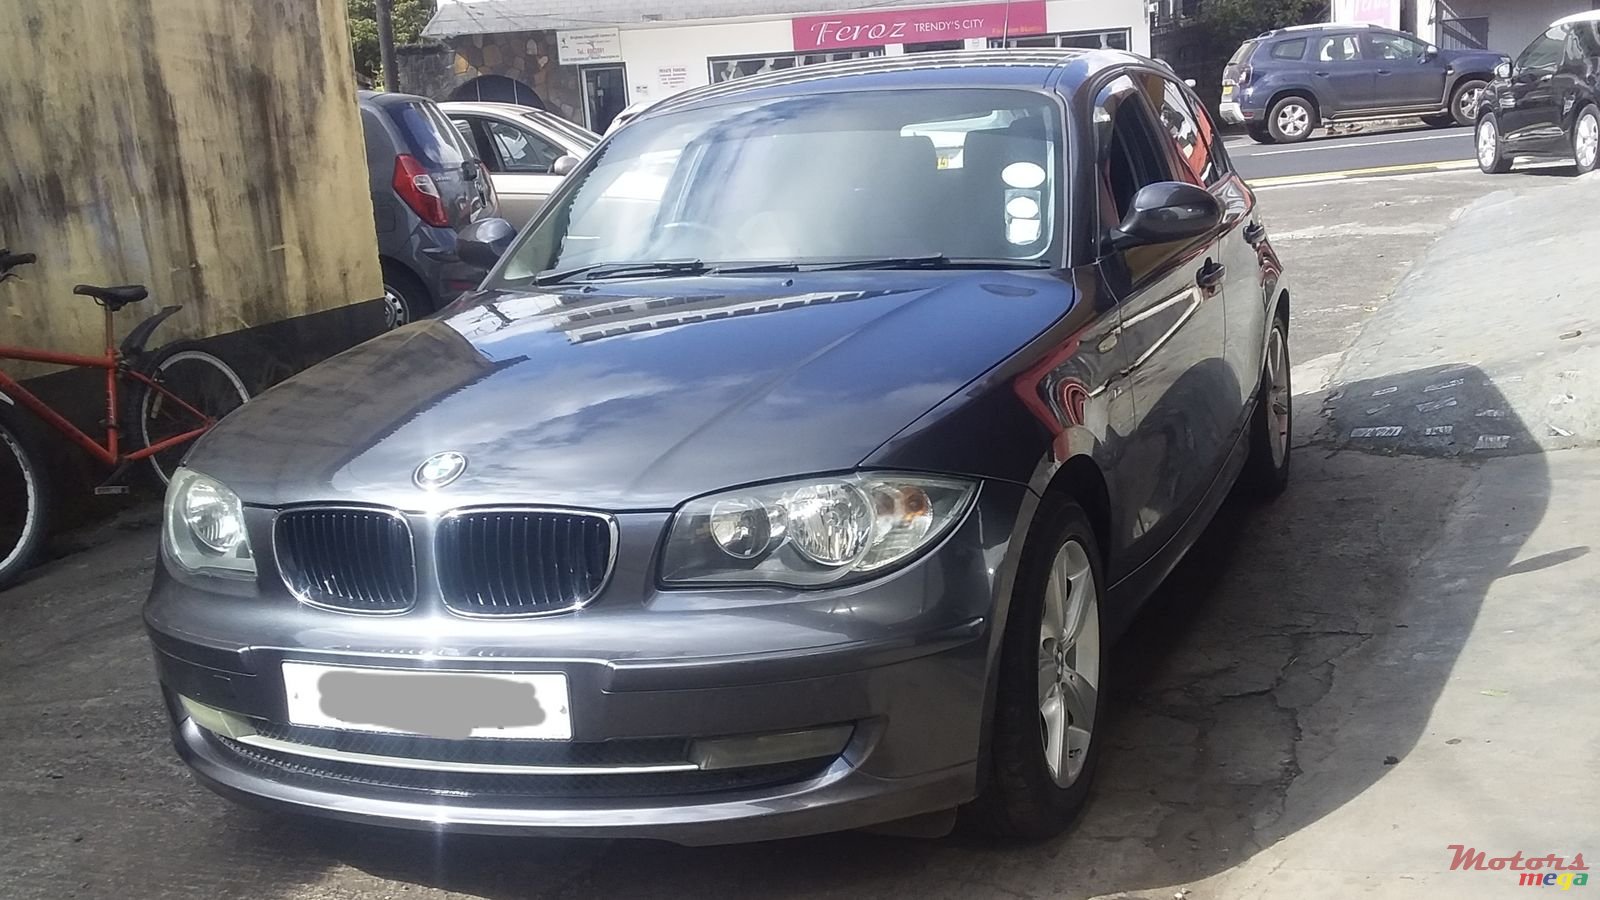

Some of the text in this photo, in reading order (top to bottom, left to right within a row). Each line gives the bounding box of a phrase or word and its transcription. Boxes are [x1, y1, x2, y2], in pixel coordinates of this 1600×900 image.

[811, 18, 985, 46] Feroz TRENDY'S CITY
